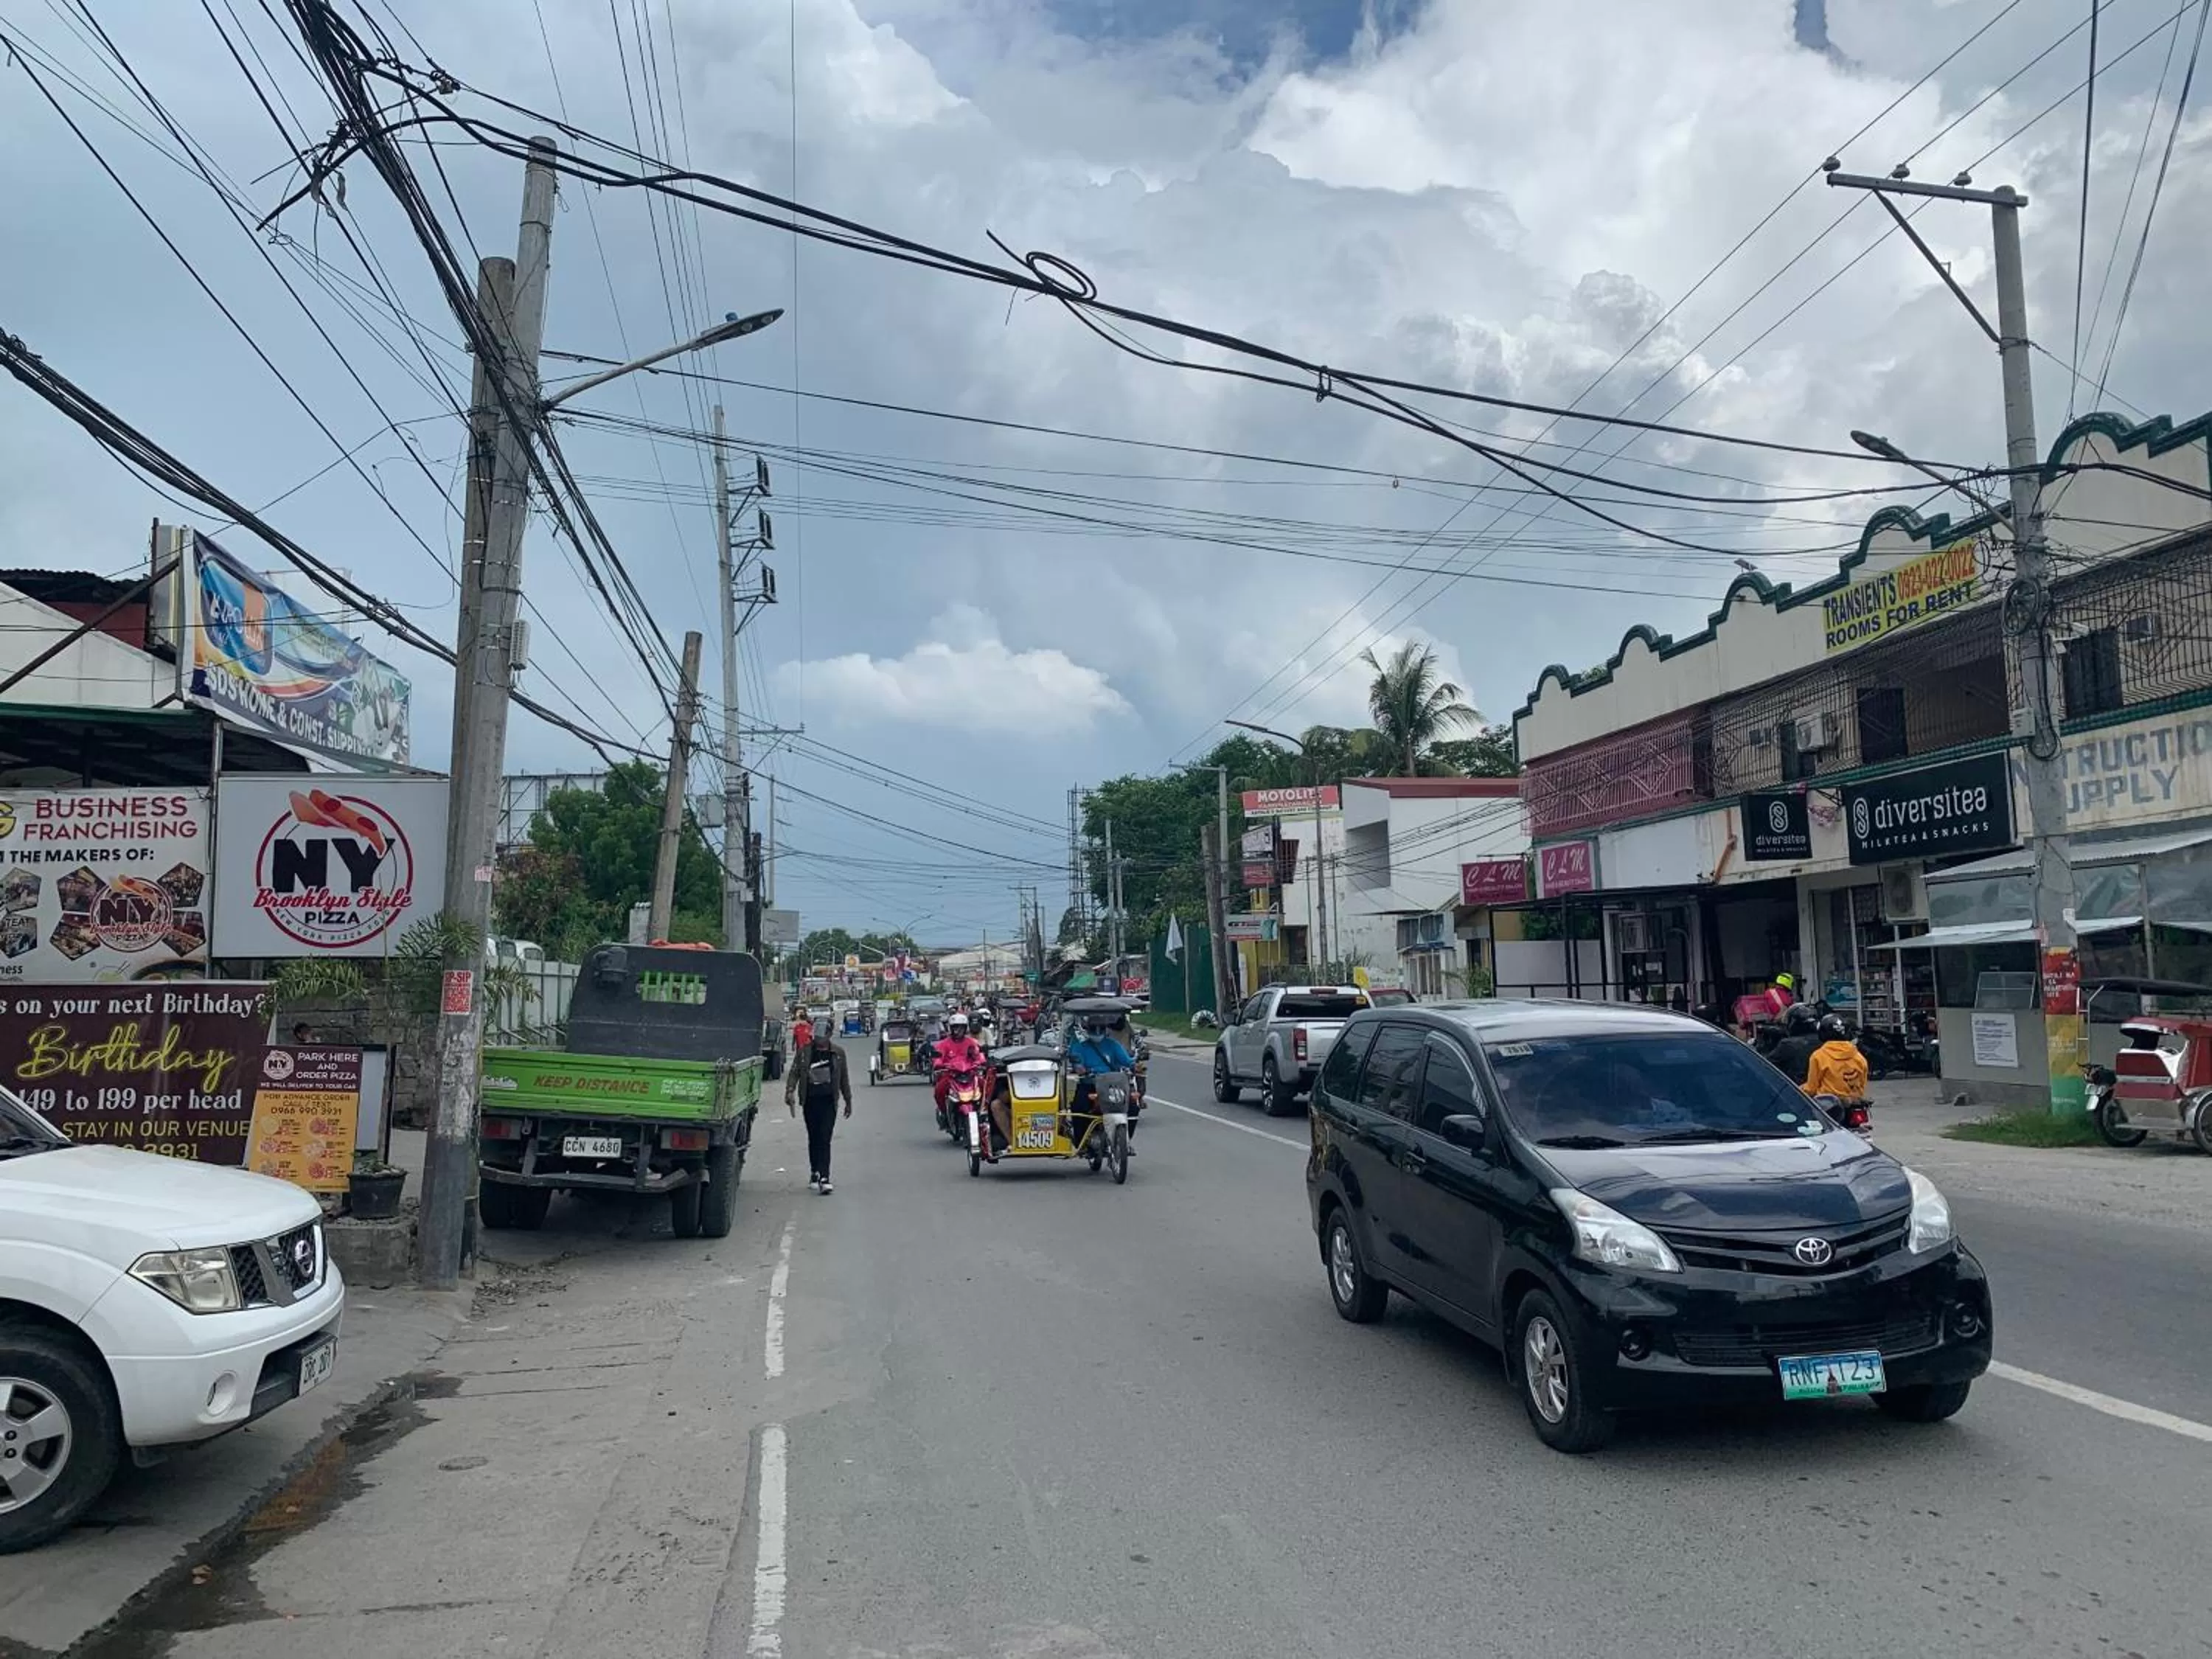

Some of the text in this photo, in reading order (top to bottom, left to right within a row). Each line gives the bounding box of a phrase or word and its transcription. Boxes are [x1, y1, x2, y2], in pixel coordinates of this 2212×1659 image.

[1823, 573, 1897, 629] TRANSIENTS
[1826, 580, 1976, 650] ROOMS FOR RENT
[238, 678, 276, 723] HOME
[277, 701, 287, 728] &
[290, 708, 325, 746] CONST.
[2065, 765, 2180, 814] UPPLY
[36, 796, 188, 819] BUSINESS
[1874, 786, 1988, 829] diversitea
[23, 820, 198, 841] FRANCHISING
[1862, 833, 1917, 849] MILKTEA
[1933, 822, 1990, 839] SNACKS
[10, 849, 41, 863] THE
[45, 848, 122, 863] MAKERS
[126, 848, 155, 861] OF:
[272, 838, 396, 894] NY
[100, 897, 156, 925] NY
[253, 887, 413, 914] Brooklyn Style
[305, 911, 361, 924] PIZZA
[15, 1000, 42, 1015] on
[49, 998, 101, 1018] your
[108, 993, 154, 1014] next
[163, 992, 267, 1018] Birthday?
[17, 1022, 237, 1093] Birthday
[297, 1052, 359, 1062] PARK HERE
[296, 1071, 357, 1080] ORDER PIZZA
[532, 1075, 573, 1090] KEEP
[574, 1077, 651, 1095] DISTANCE
[66, 1088, 89, 1112] to
[97, 1087, 137, 1110] 199
[142, 1092, 184, 1115] per
[189, 1088, 242, 1110] head
[62, 1119, 250, 1139] STAY IN OUR VENUE
[1016, 1130, 1054, 1150] 14509
[563, 1139, 585, 1153] CCN
[1789, 1358, 1876, 1386] RNF 123
